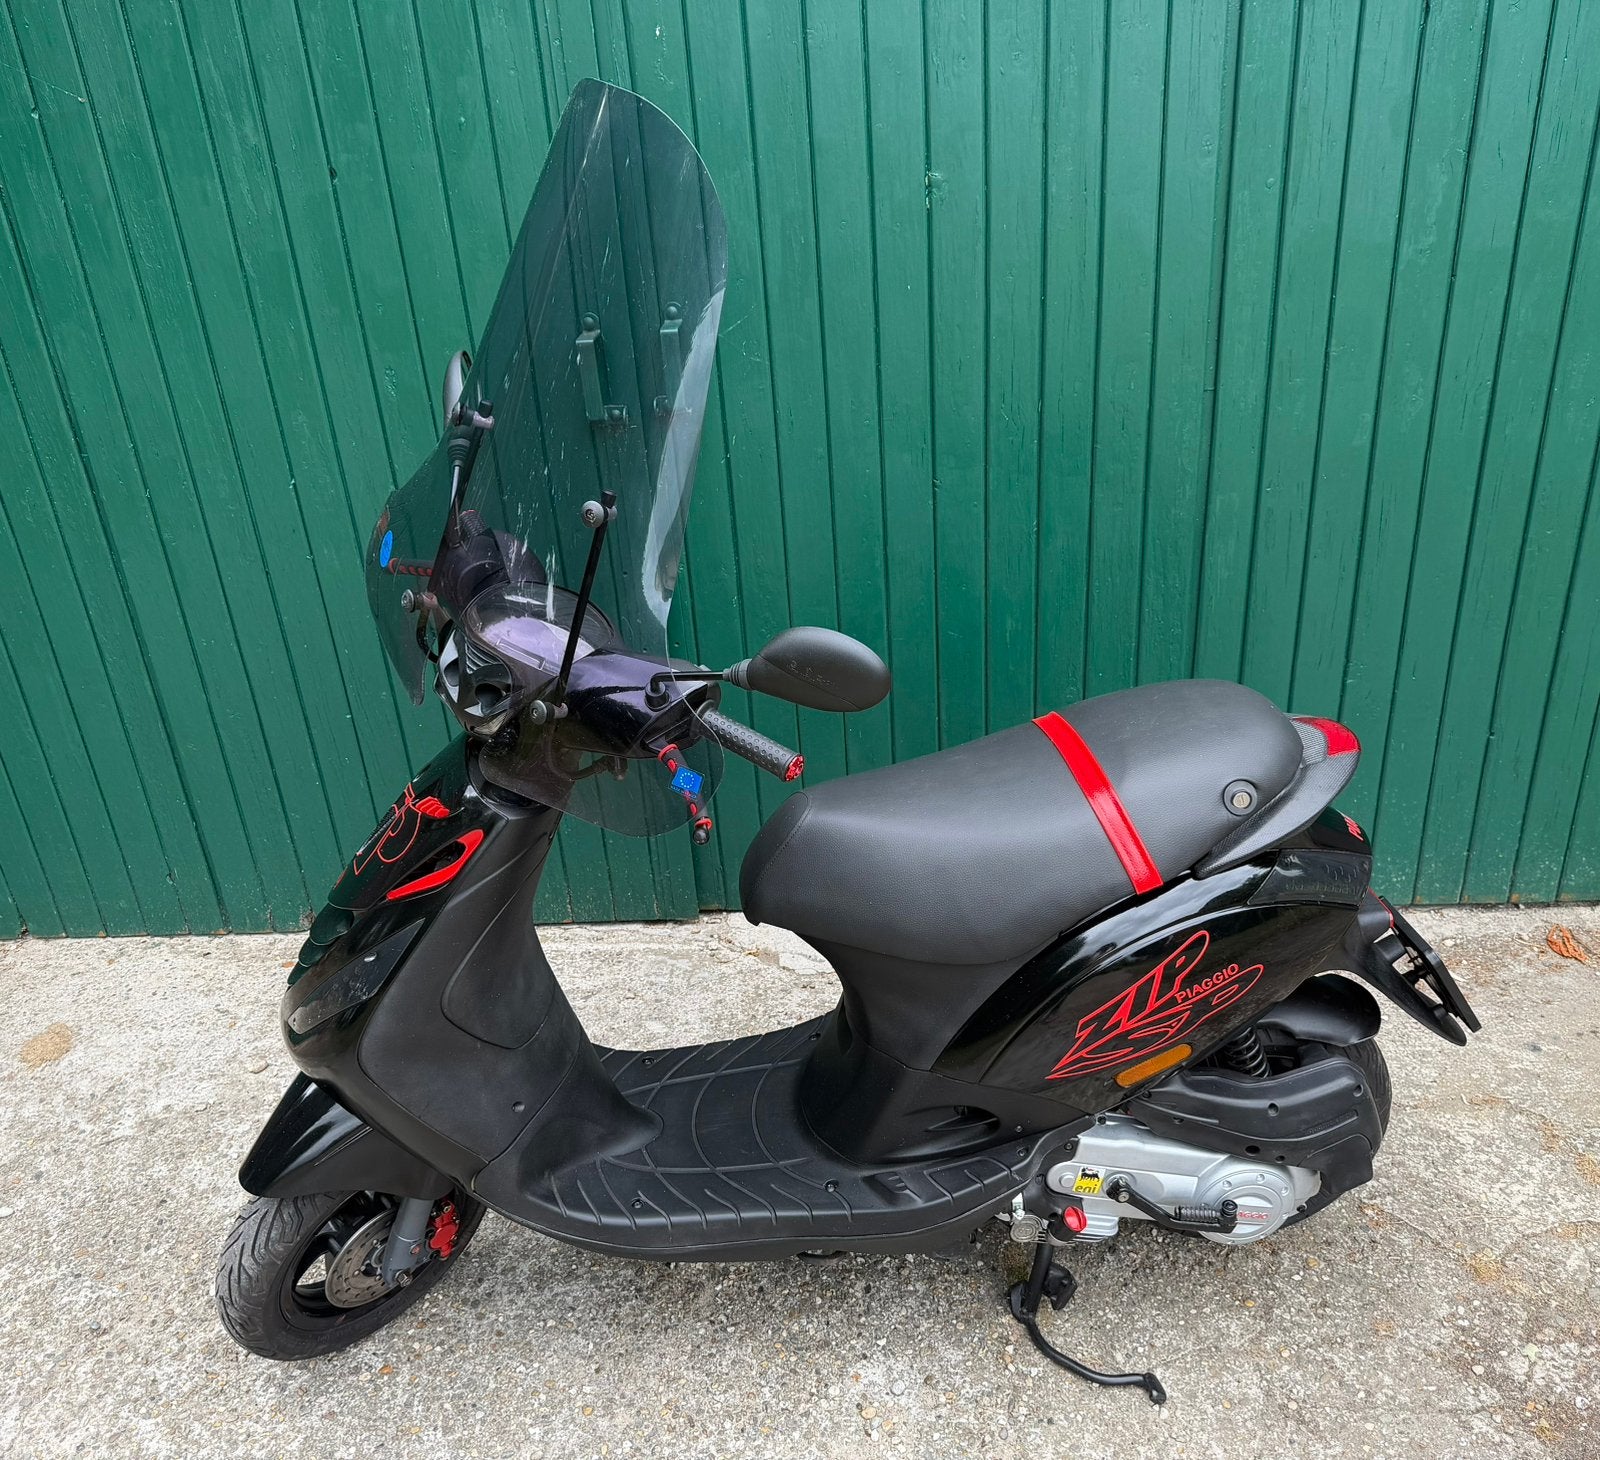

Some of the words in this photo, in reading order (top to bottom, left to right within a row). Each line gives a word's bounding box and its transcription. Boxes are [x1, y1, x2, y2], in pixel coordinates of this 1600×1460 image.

[1175, 963, 1240, 1003] PIAGGIO
[1075, 1184, 1098, 1193] eni
[1237, 1211, 1269, 1220] AGGIO
